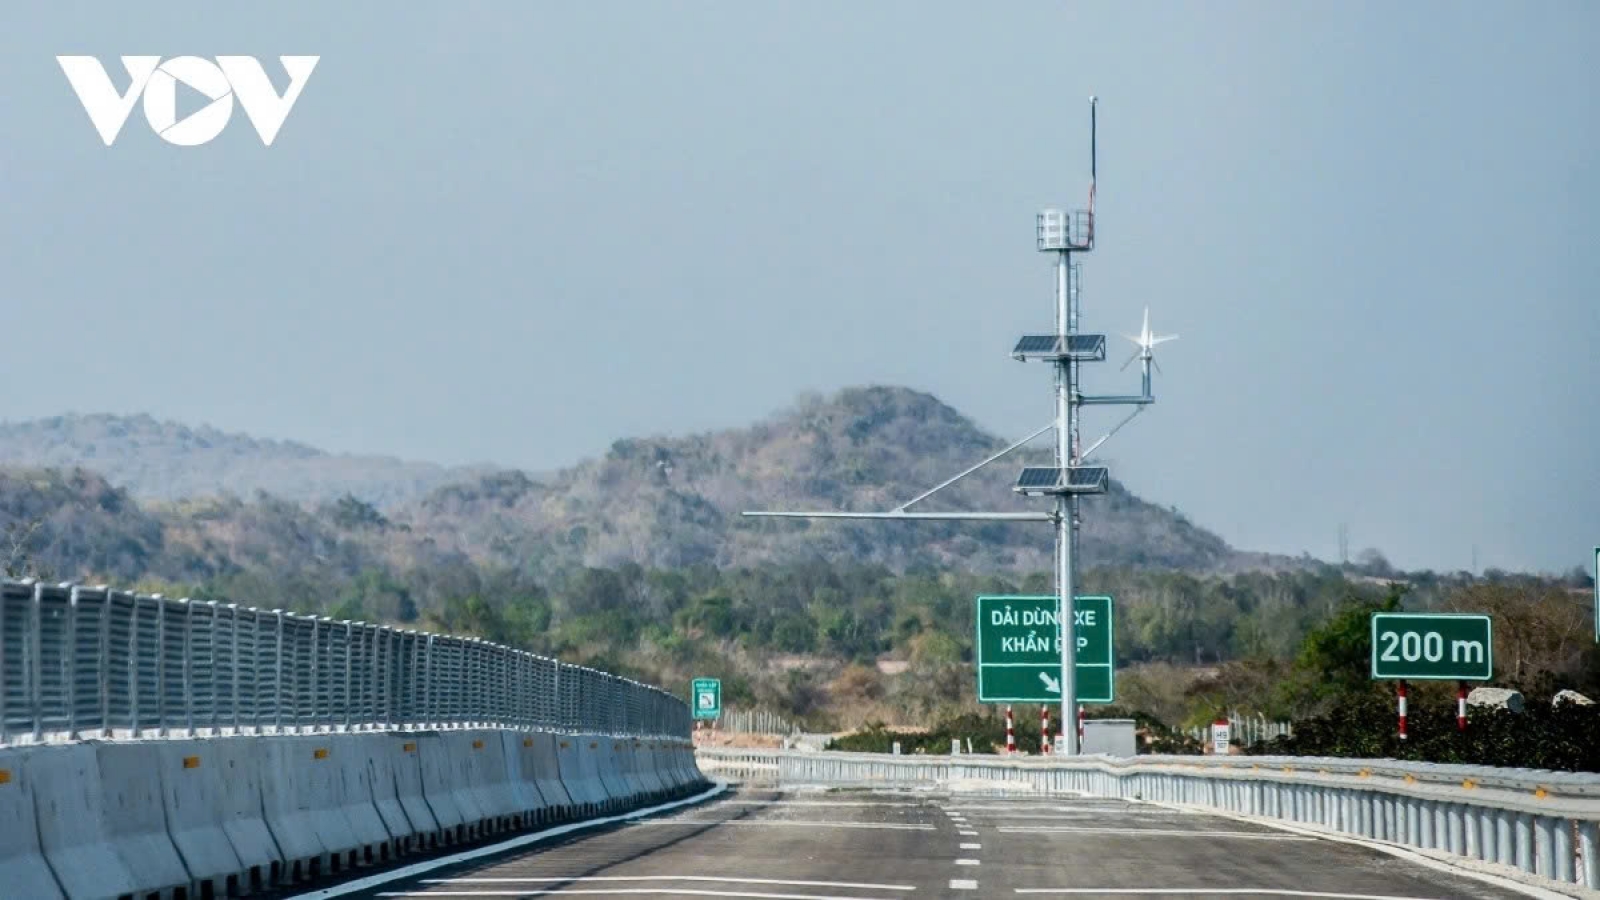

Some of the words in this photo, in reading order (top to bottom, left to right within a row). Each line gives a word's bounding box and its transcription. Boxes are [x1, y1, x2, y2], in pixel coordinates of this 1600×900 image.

[991, 605, 1018, 626] DẢI
[1074, 610, 1097, 626] XE
[1002, 630, 1049, 652] KHẨN
[1380, 631, 1444, 662] 200
[1451, 639, 1484, 664] m
